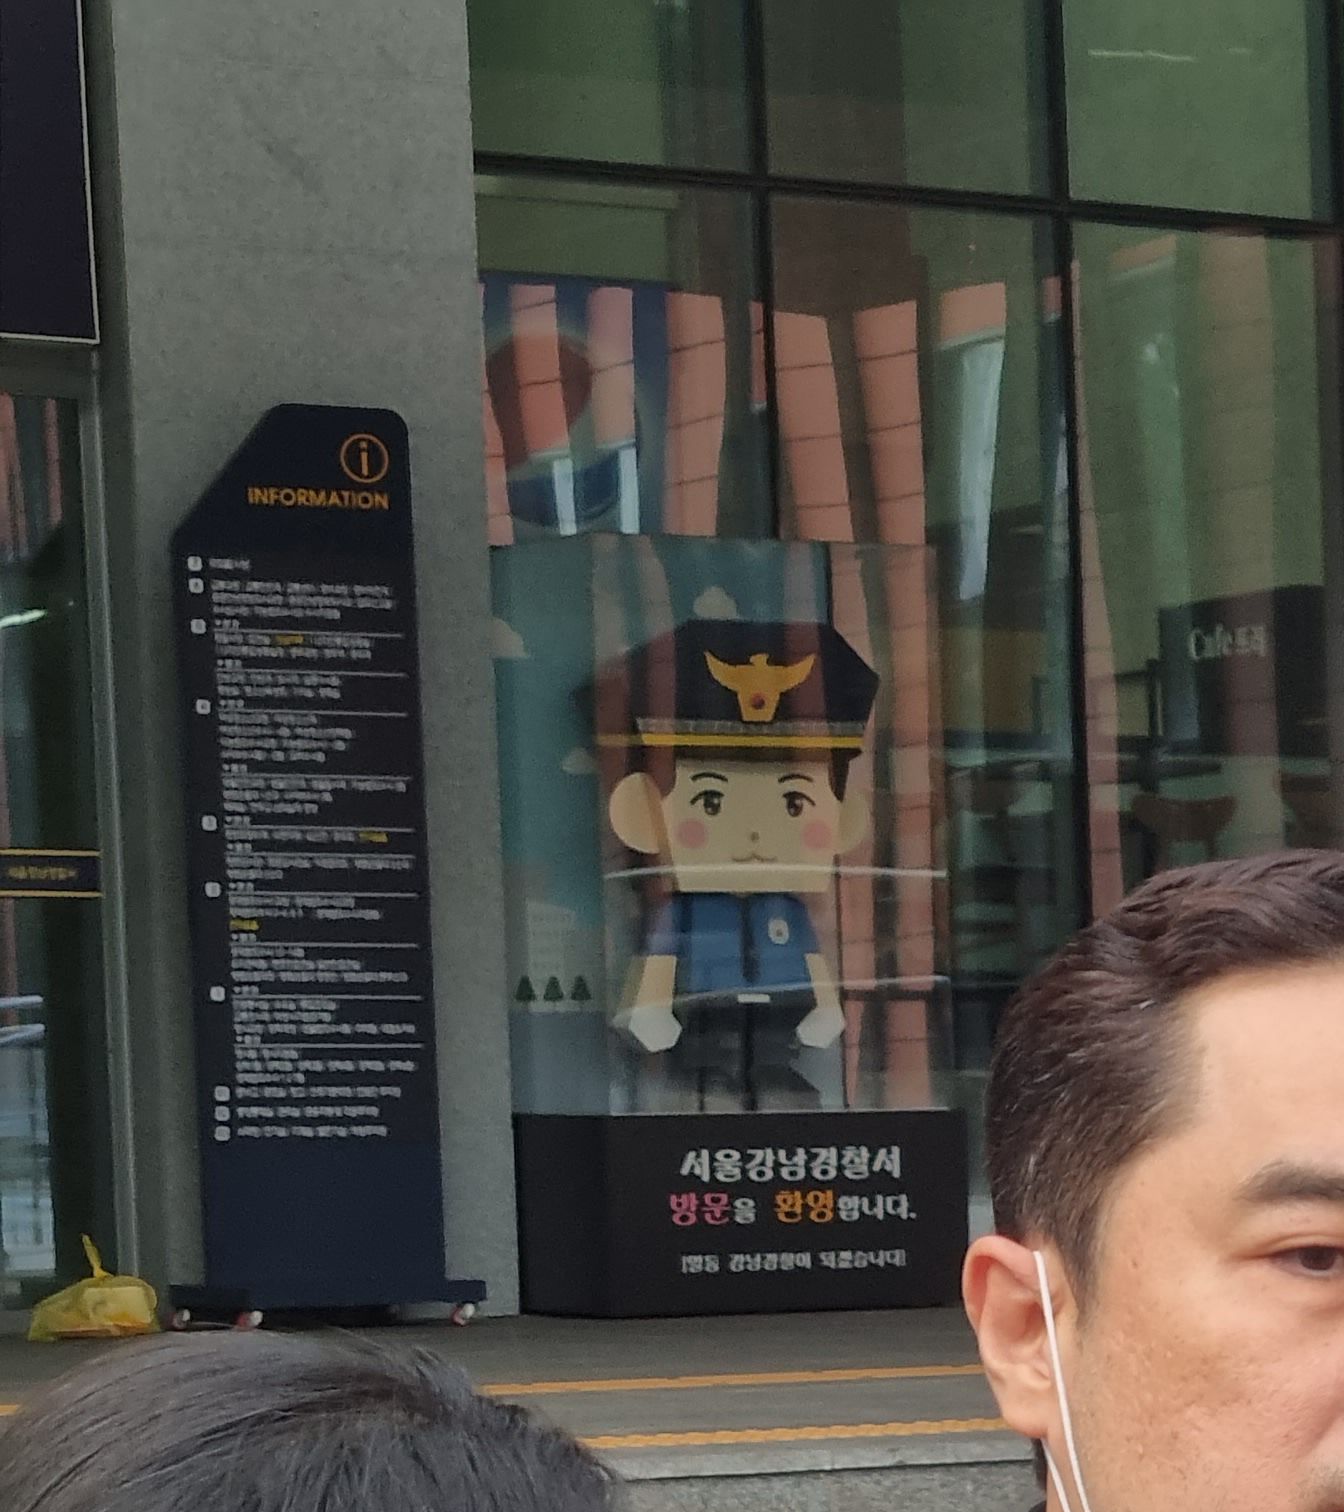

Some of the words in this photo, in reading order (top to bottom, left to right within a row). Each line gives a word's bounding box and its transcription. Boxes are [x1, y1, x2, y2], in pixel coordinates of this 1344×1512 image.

[247, 486, 389, 509] INFORMATION
[680, 1146, 900, 1182] 서울강남경찰서
[669, 1192, 756, 1225] 방문을
[774, 1189, 917, 1223] 환영합니다.
